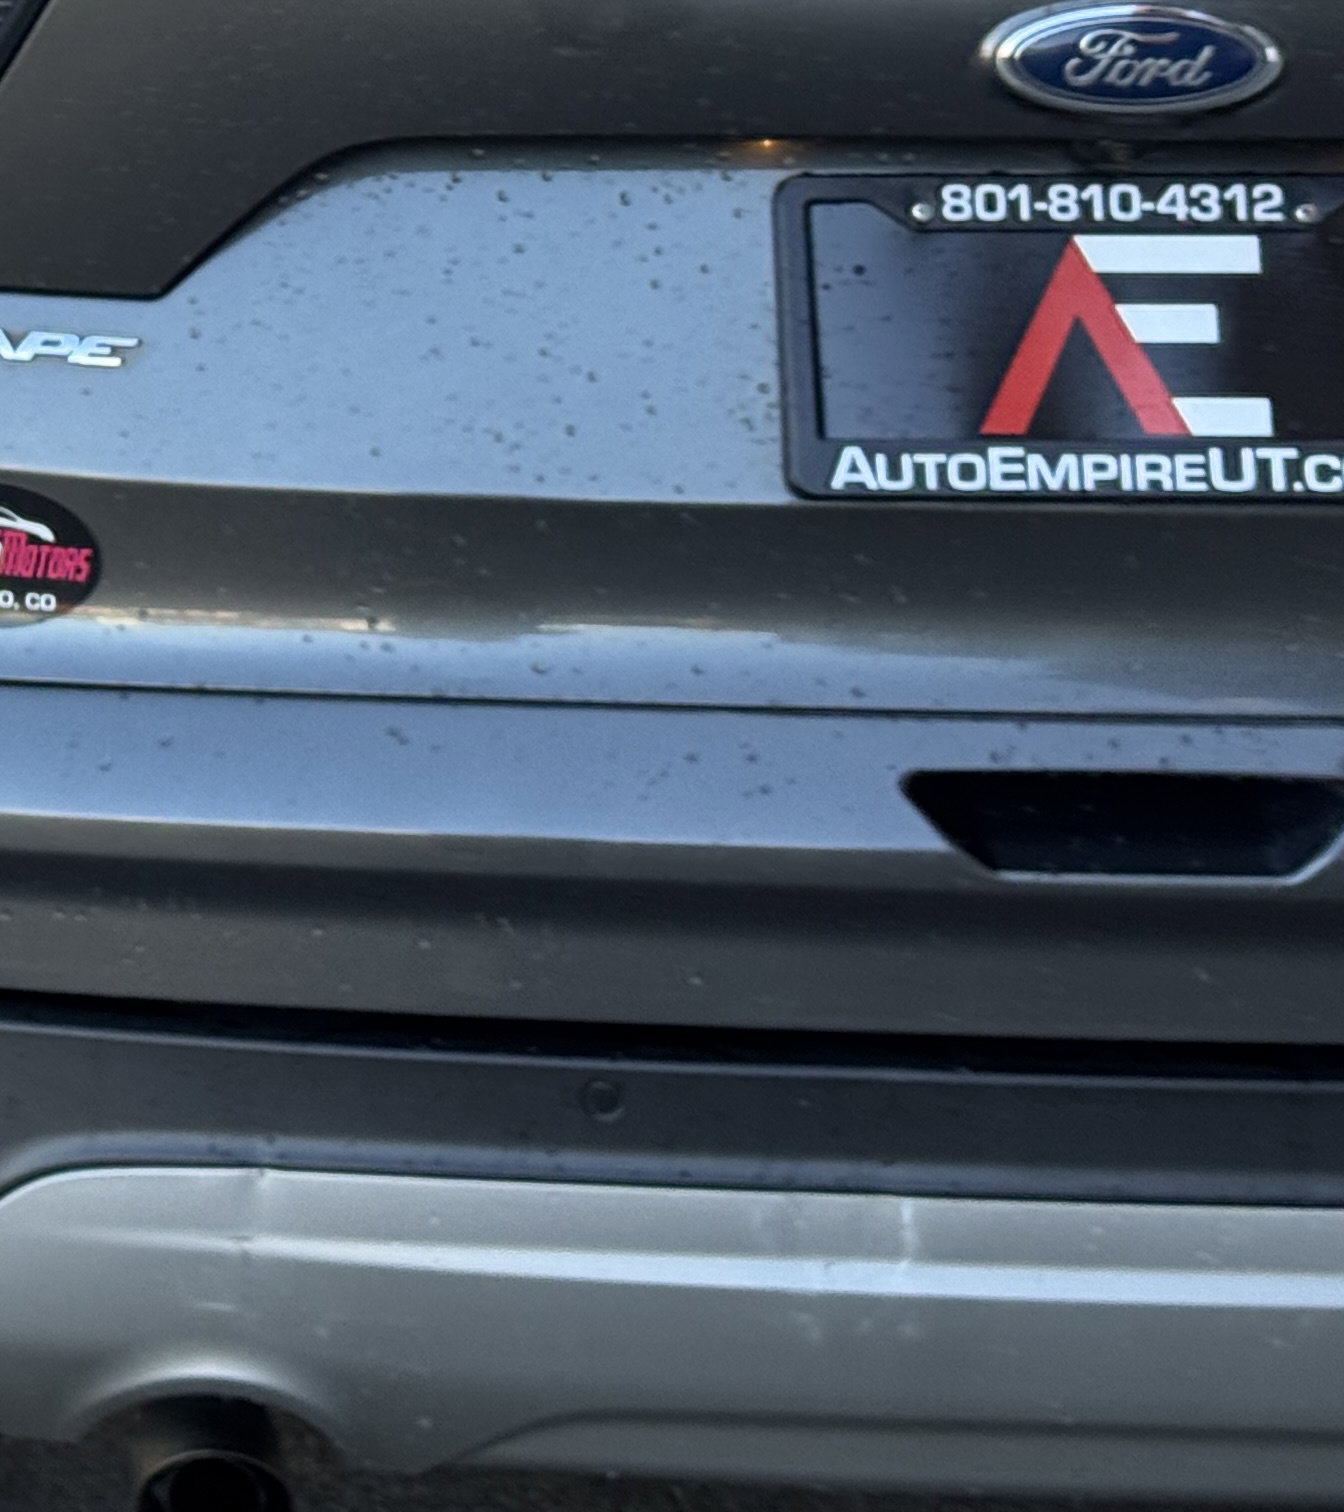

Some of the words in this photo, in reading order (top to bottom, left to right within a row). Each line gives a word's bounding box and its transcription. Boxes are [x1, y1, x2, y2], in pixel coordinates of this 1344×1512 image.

[1062, 28, 1215, 88] Ford
[941, 183, 1285, 223] 801-810-4312
[830, 446, 1344, 494] AUTOEMPIREUT.C
[25, 592, 57, 612] CO
